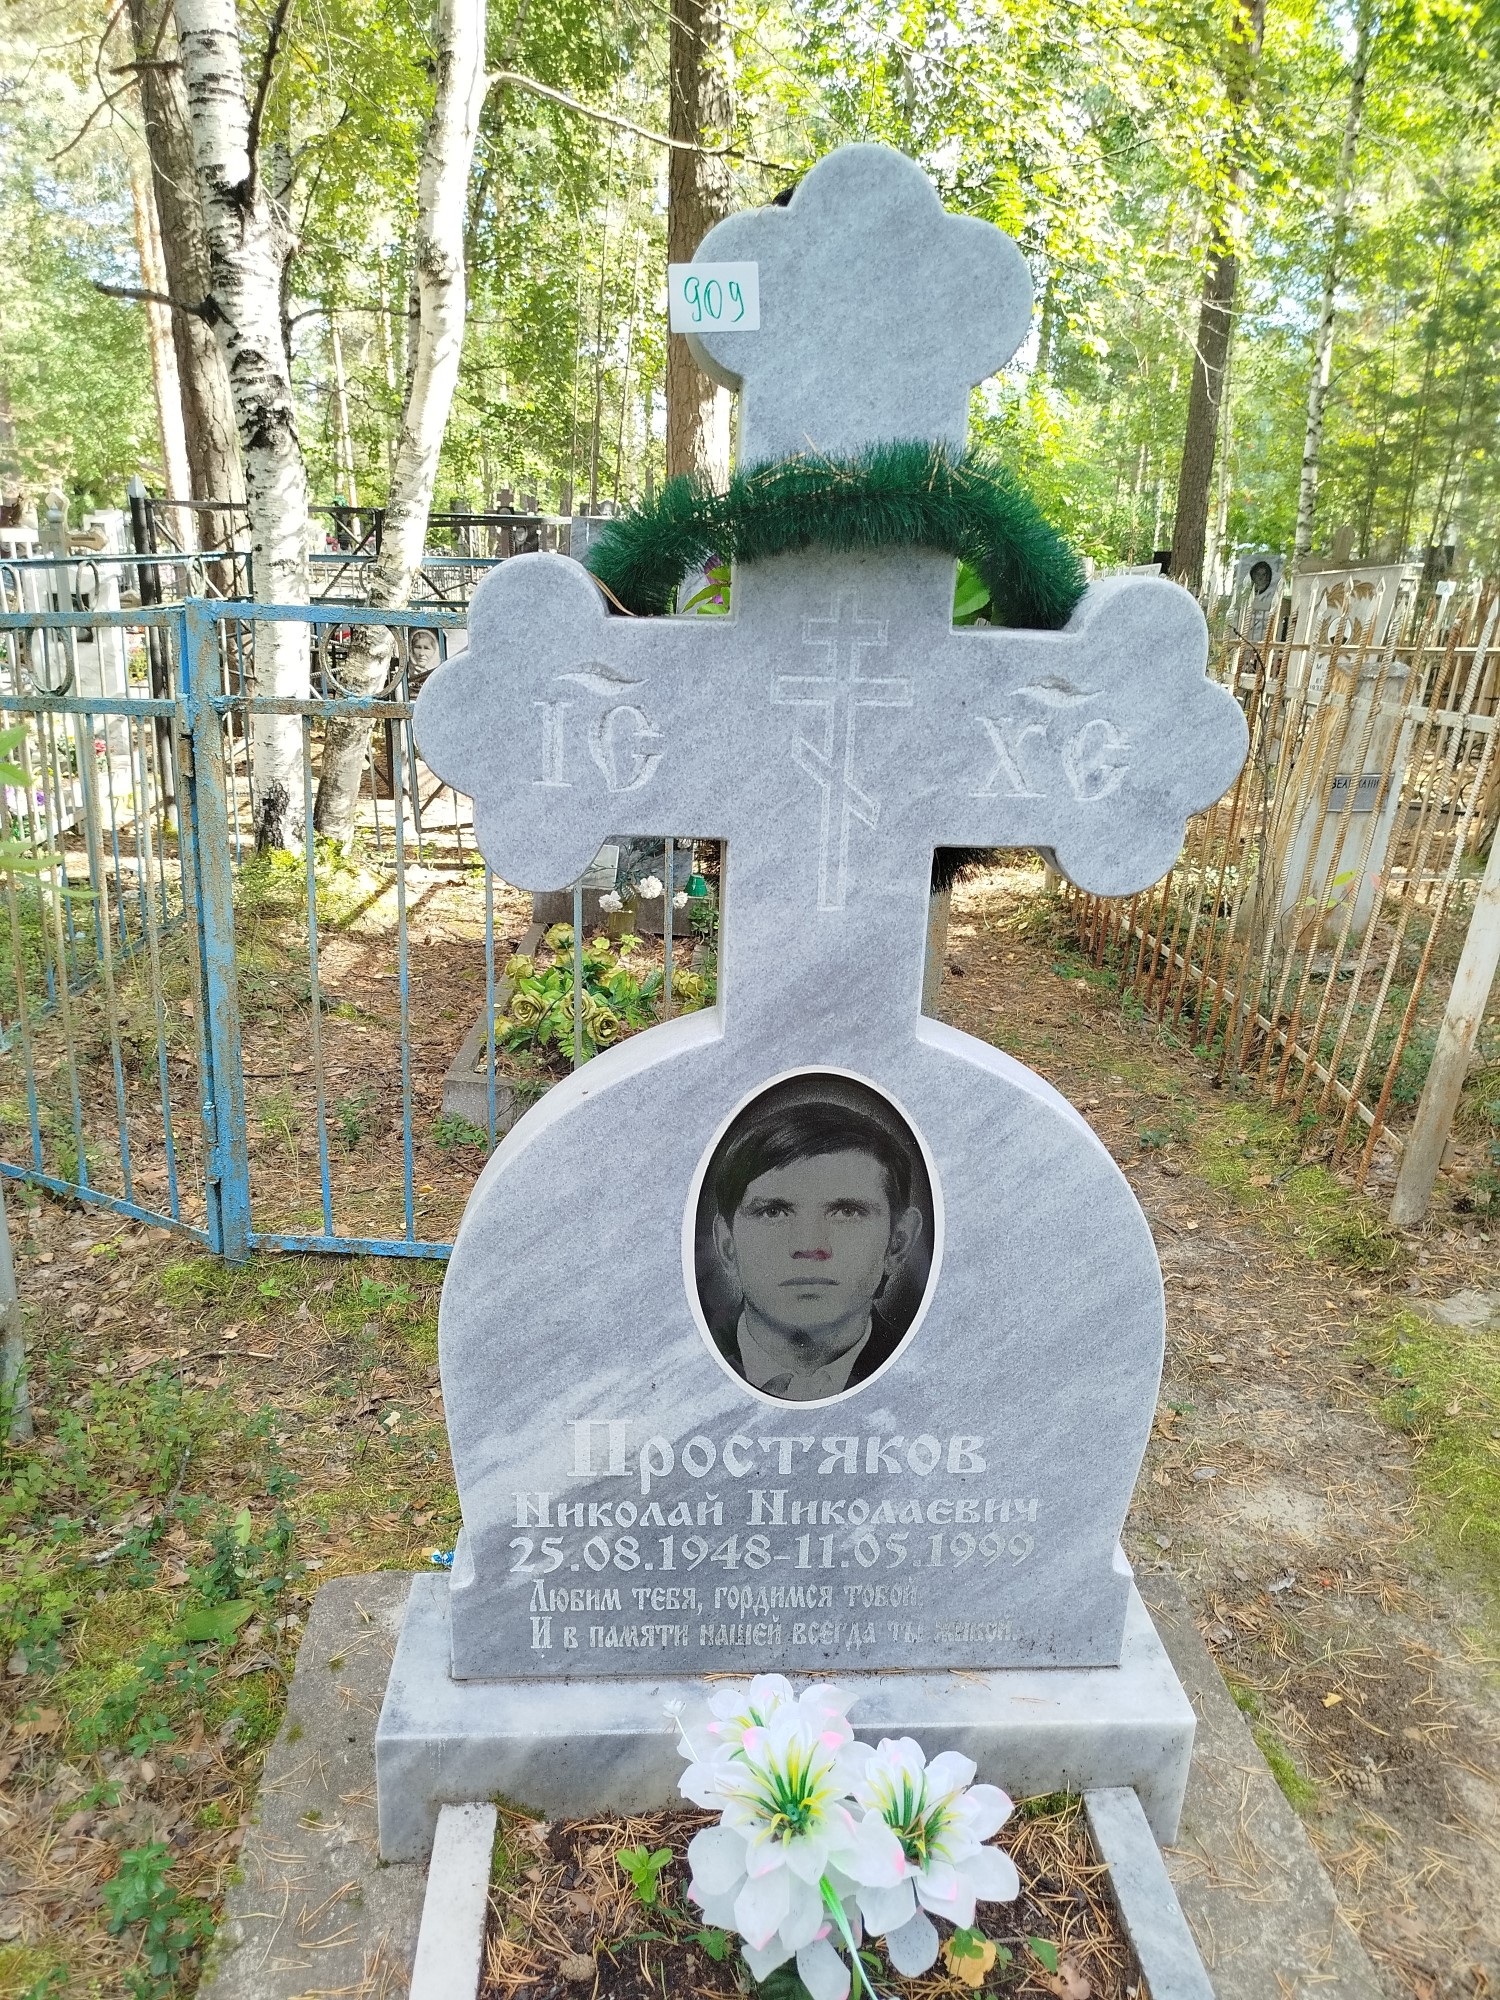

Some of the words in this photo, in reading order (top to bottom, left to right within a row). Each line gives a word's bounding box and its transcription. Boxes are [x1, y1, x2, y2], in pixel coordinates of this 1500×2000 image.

[684, 276, 745, 323] 909
[566, 1419, 987, 1495] Простяков
[511, 1490, 724, 1528] Николай
[746, 1488, 1039, 1526] Николаевич
[529, 1578, 623, 1613] Любим
[631, 1586, 703, 1616] тебя,
[714, 1584, 833, 1619] гордимся
[529, 1616, 553, 1649] И
[563, 1625, 579, 1649] в
[589, 1623, 690, 1649] памяти
[700, 1614, 782, 1647] нашей
[792, 1620, 877, 1652] всегда
[887, 1619, 924, 1643] ты
